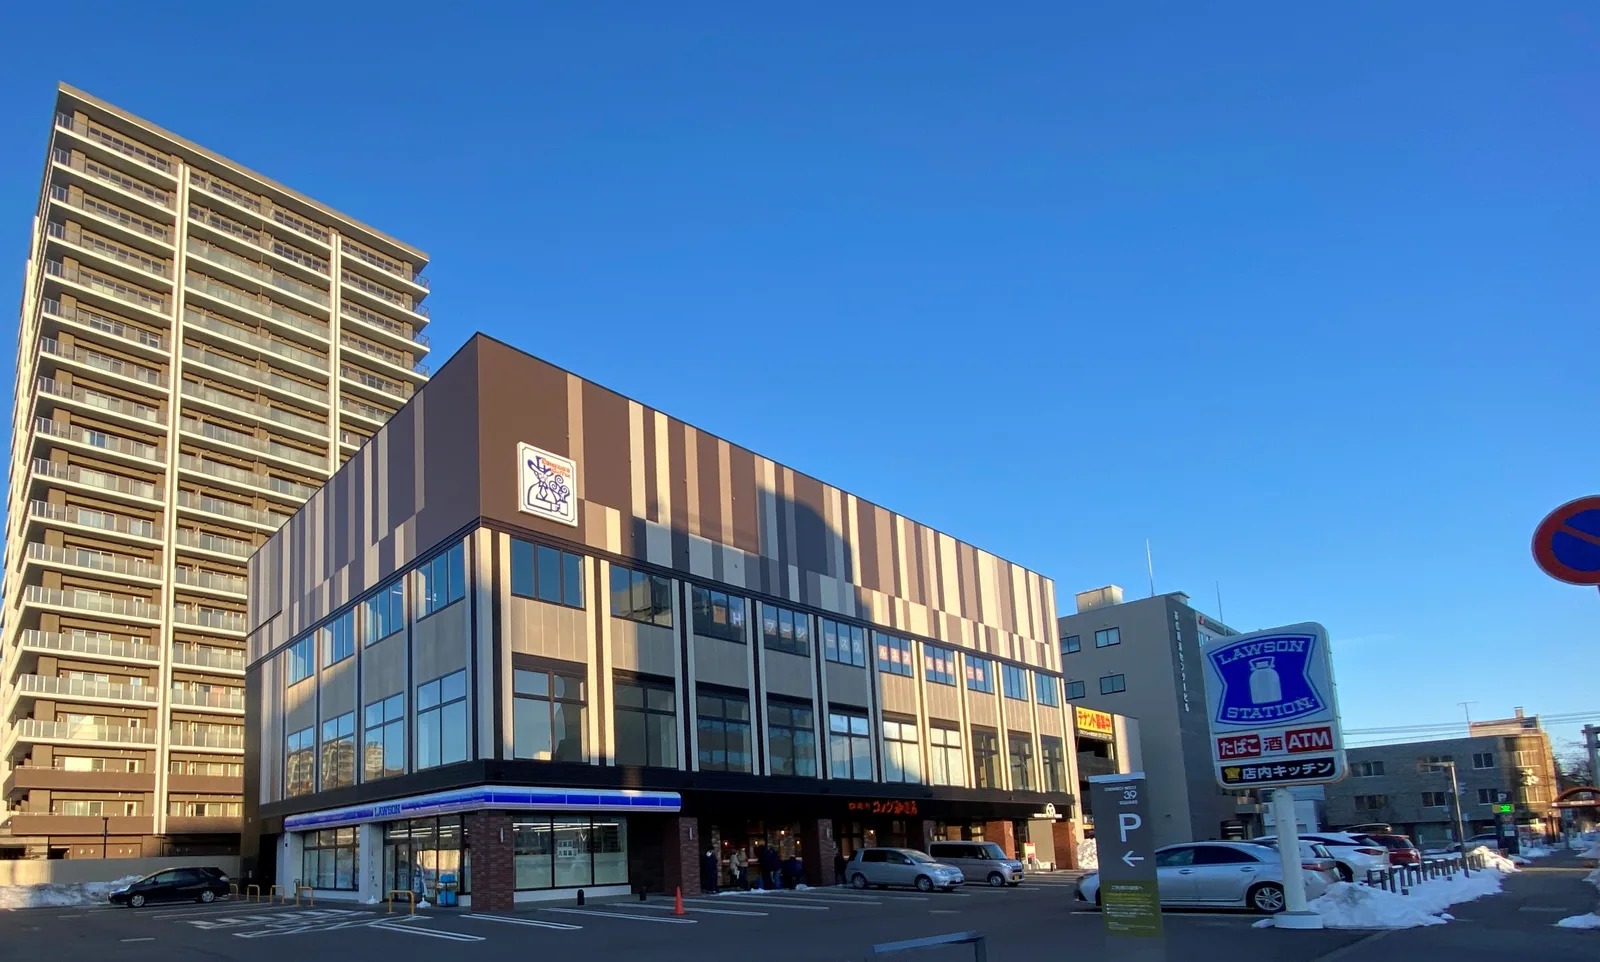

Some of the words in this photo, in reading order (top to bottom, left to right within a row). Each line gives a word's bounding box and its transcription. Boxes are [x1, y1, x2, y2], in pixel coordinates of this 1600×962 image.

[1218, 640, 1305, 665] LAWSON
[1226, 697, 1314, 719] STATION
[1078, 711, 1111, 731] テナント募集中
[1220, 738, 1260, 756] たばこ
[1288, 731, 1330, 749] ATM
[1242, 762, 1332, 780] 店内キッチン
[1123, 790, 1138, 800] 39
[375, 804, 400, 816] LAWSON
[1119, 813, 1142, 842] P
